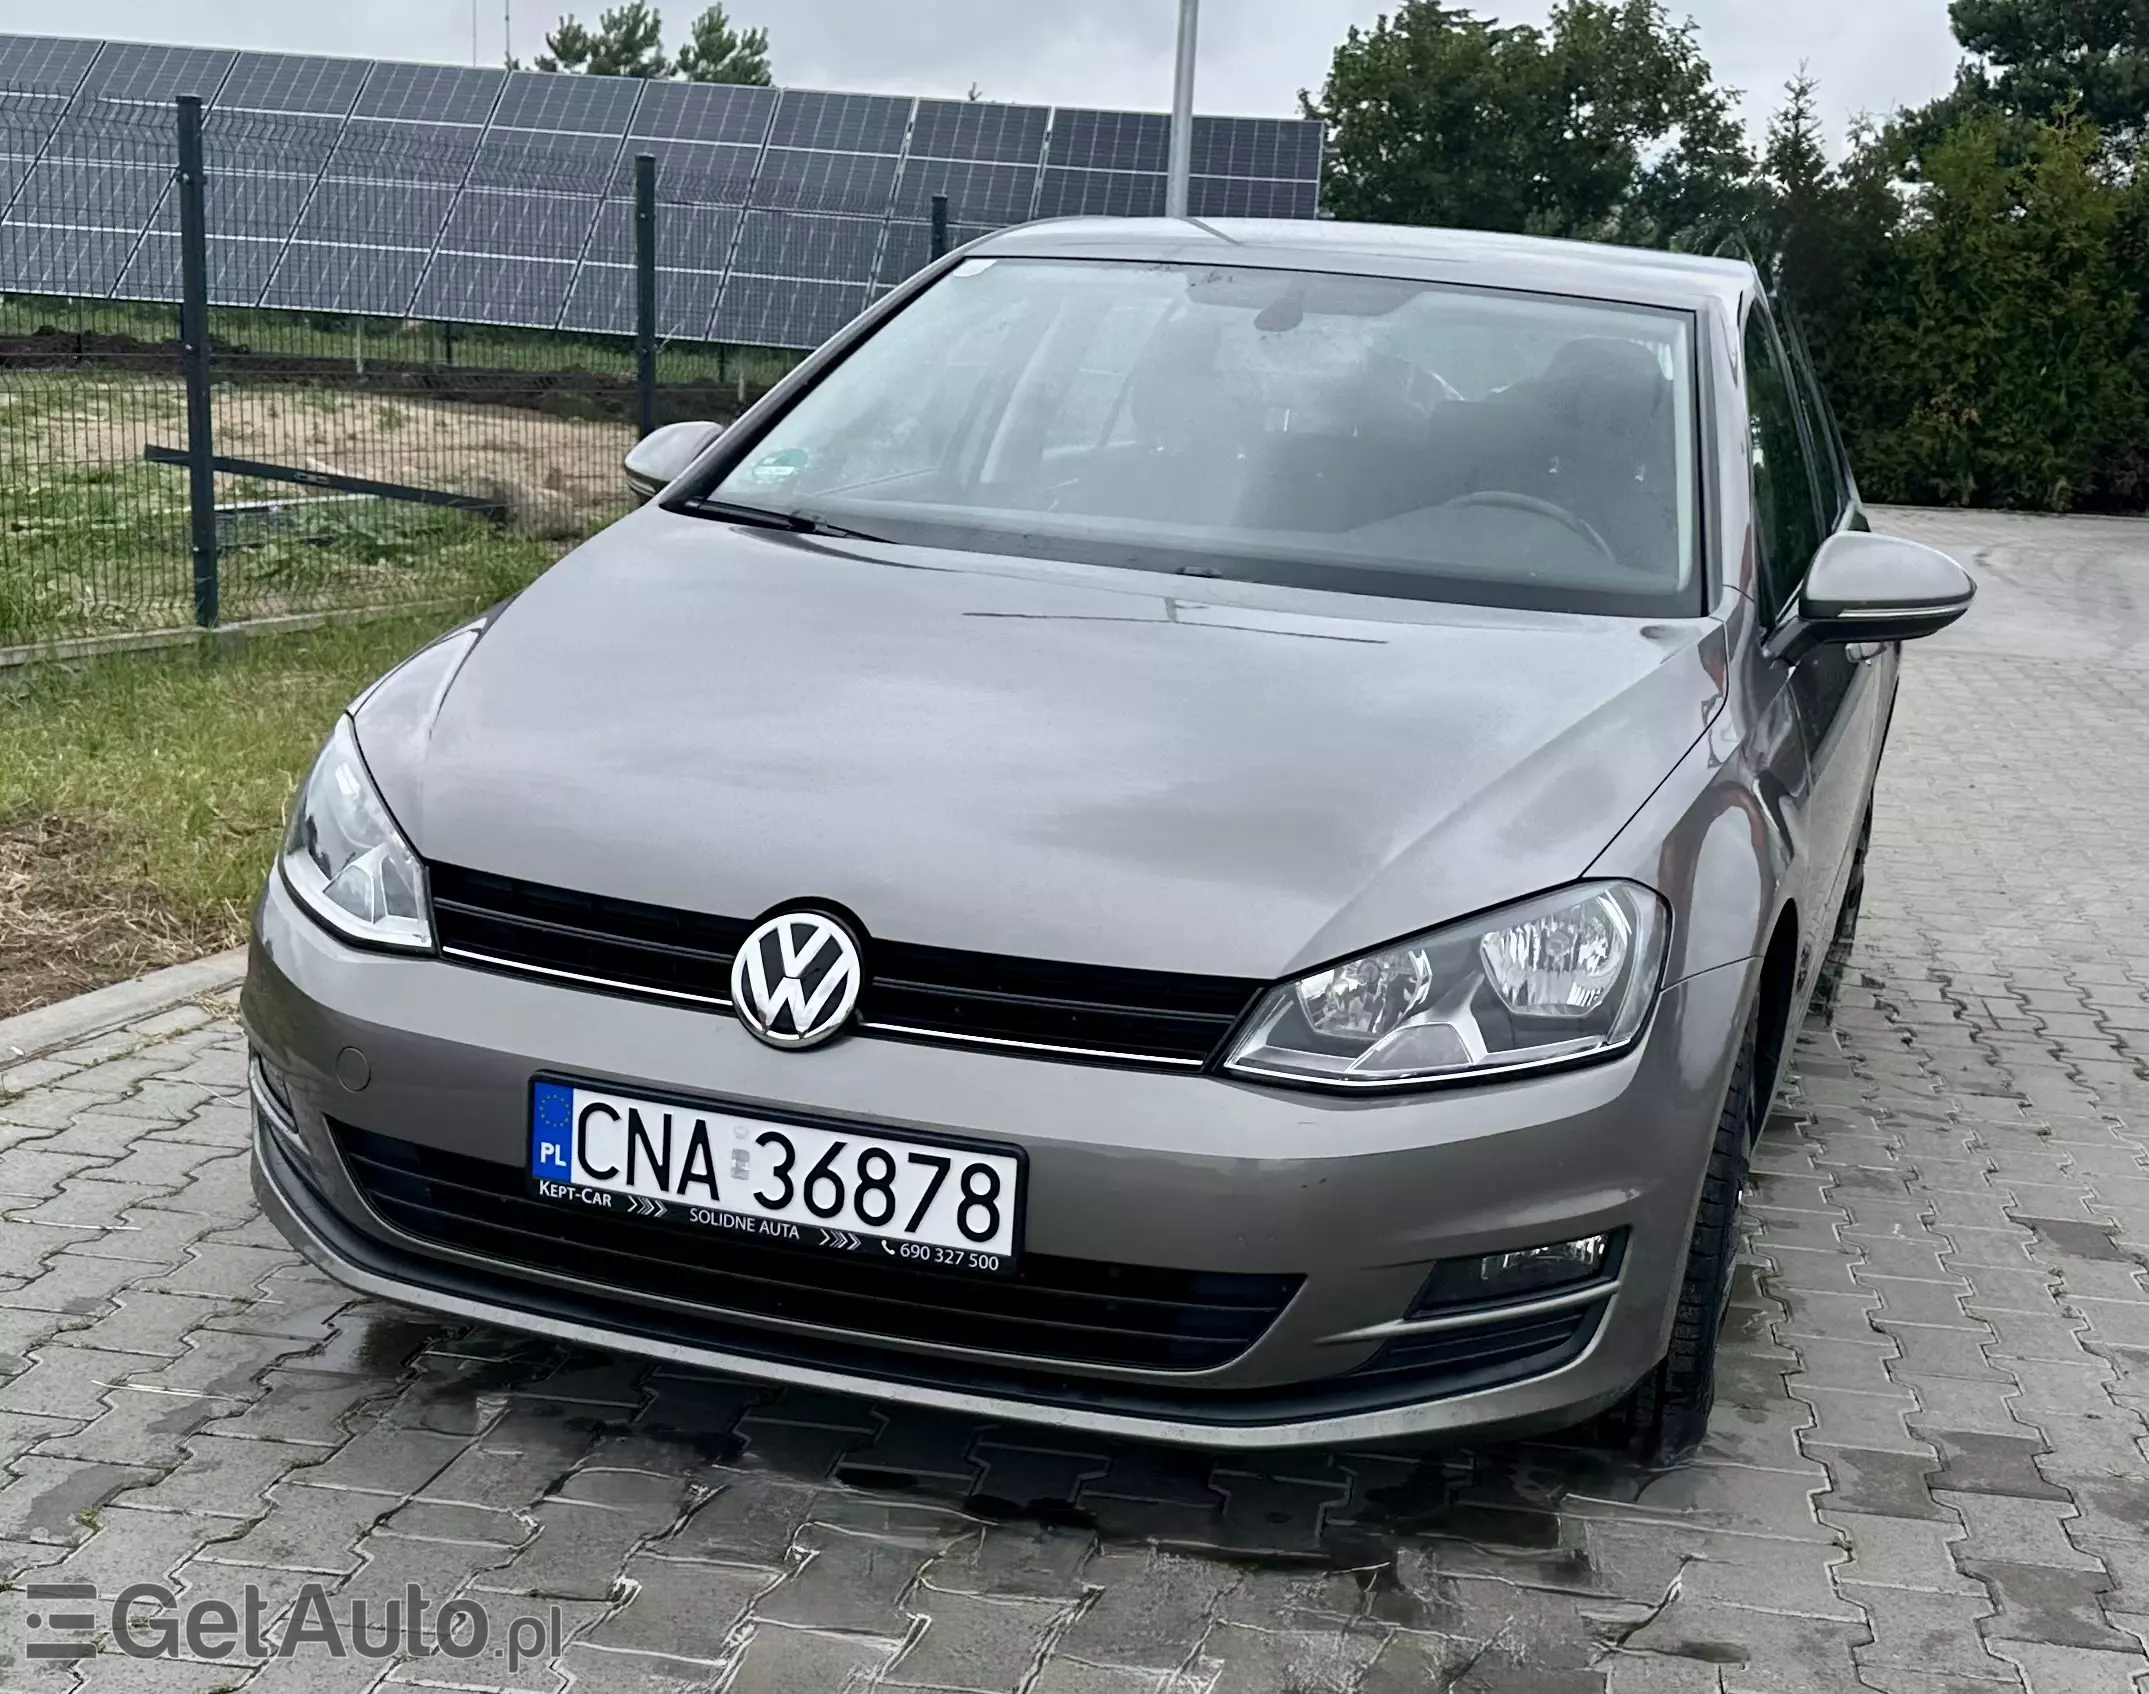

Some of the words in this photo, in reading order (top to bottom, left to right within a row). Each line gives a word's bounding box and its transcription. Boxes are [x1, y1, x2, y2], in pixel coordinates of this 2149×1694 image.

[540, 1142, 566, 1167] PL
[577, 1101, 720, 1201] CNA
[753, 1130, 999, 1243] 36878
[539, 1181, 612, 1208] KEPT-CAR
[689, 1207, 755, 1233] SOLIDNE
[760, 1218, 800, 1240] AUTA
[900, 1242, 930, 1261] 690
[934, 1247, 964, 1265] 327
[968, 1253, 999, 1271] 500
